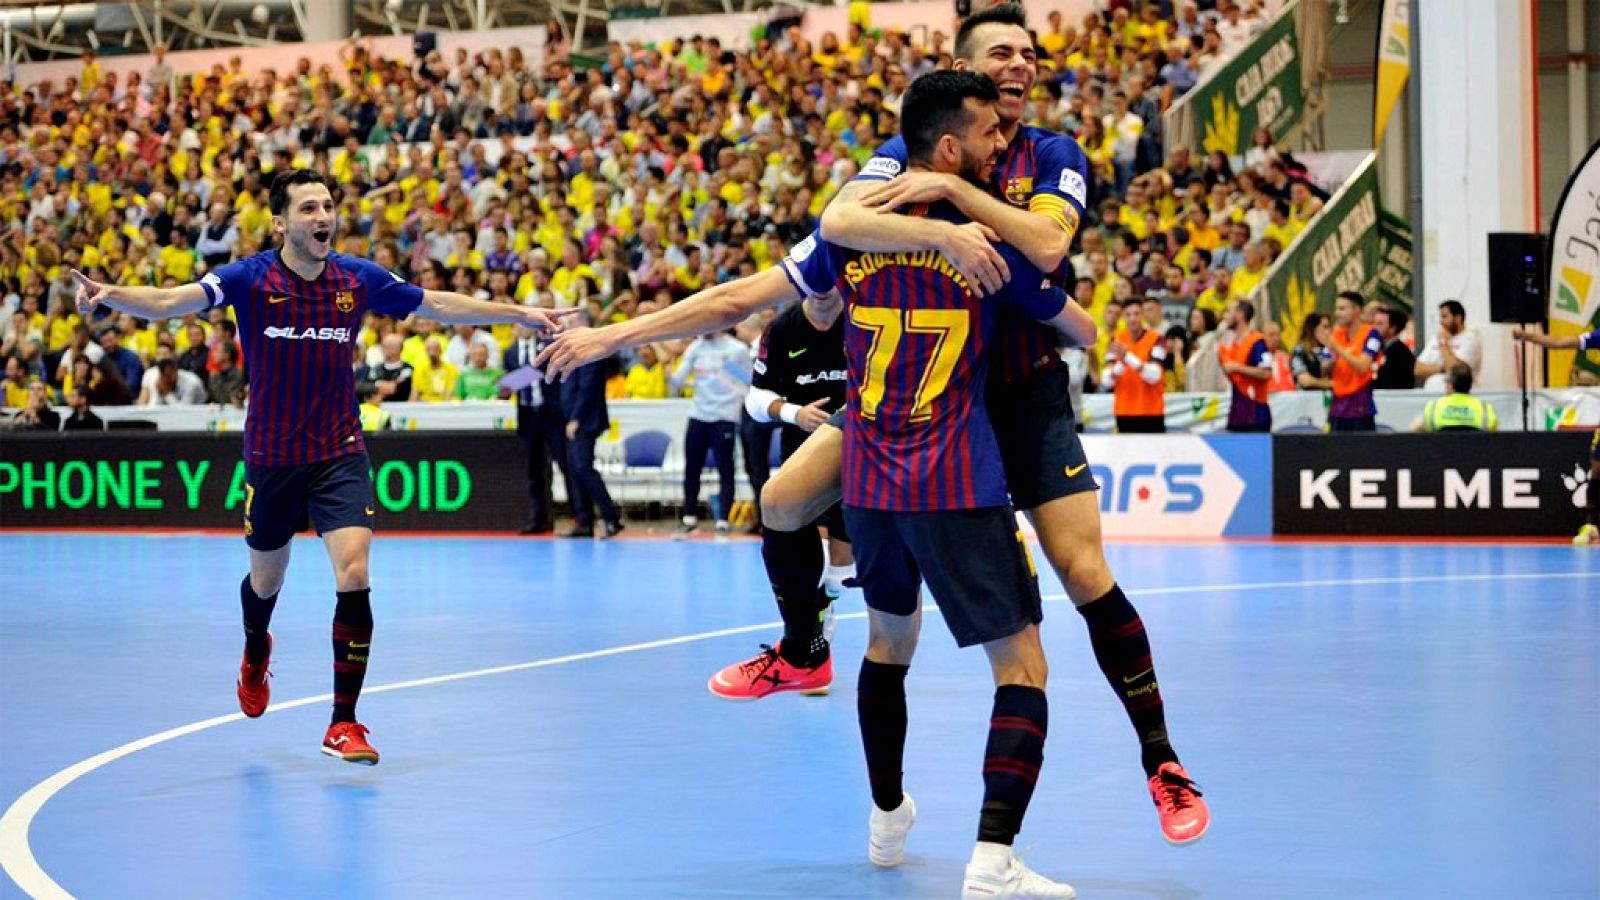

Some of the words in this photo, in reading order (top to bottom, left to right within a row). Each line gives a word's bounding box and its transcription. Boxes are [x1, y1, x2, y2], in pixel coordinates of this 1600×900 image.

[850, 303, 970, 422] 77
[176, 460, 210, 510] Y
[1299, 468, 1540, 509] KELME
